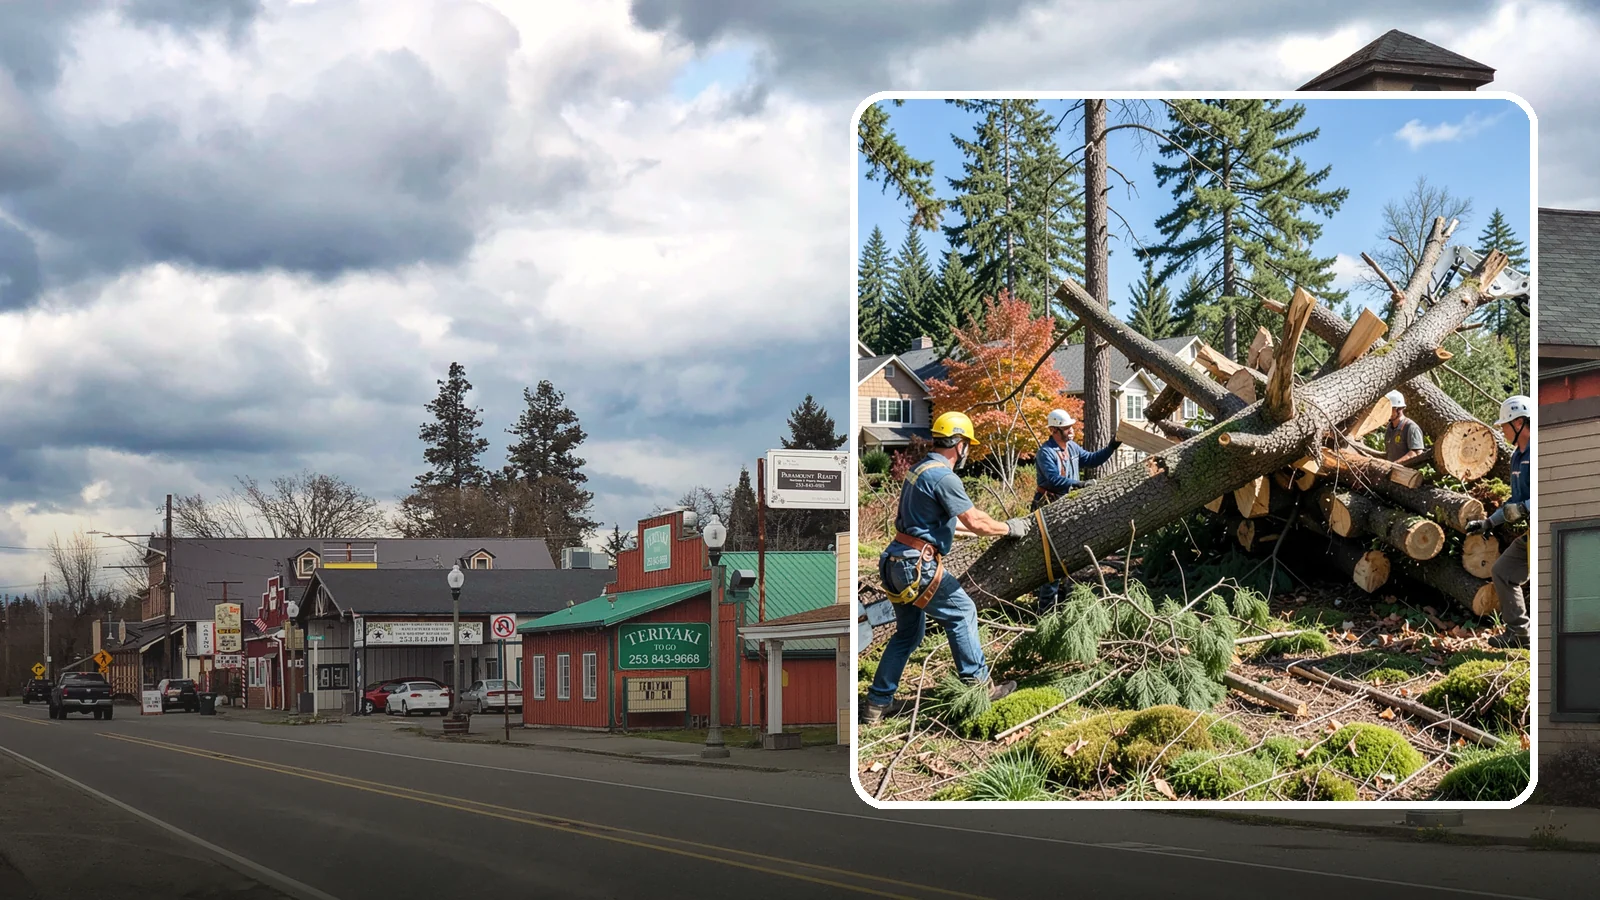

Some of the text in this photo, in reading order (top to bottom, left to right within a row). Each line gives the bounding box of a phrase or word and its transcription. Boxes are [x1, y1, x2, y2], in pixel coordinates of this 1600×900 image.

[781, 471, 815, 479] PARAMOUNT
[624, 627, 703, 646] TERIYAKI
[628, 654, 700, 665] 253 843-9668
